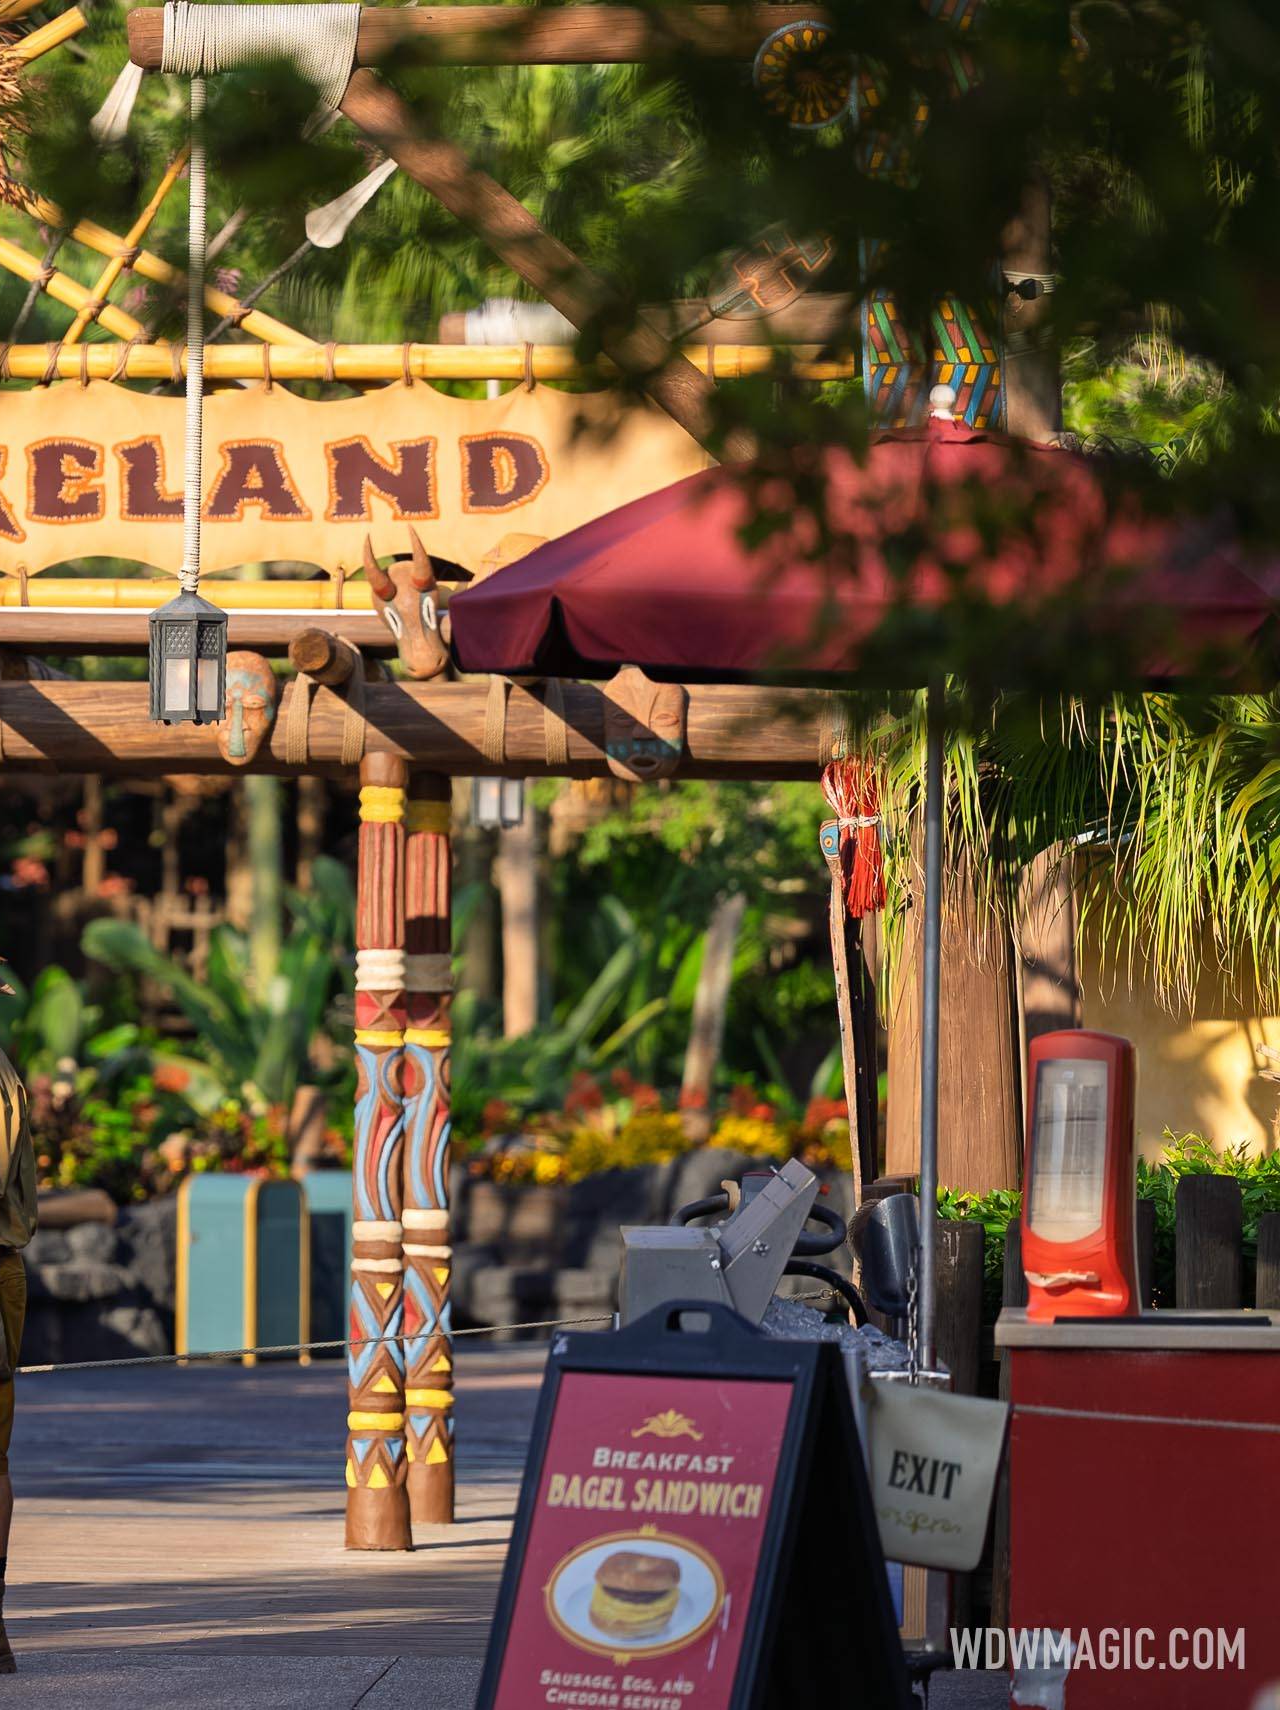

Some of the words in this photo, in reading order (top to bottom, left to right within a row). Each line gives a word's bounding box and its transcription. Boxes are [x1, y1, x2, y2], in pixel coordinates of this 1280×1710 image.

[592, 1446, 734, 1473] BREAKFAST
[887, 1449, 962, 1500] EXIT
[546, 1473, 627, 1511] BAGEL
[631, 1478, 764, 1518] SANDWICH
[539, 1669, 617, 1690] SAUSAGE,
[662, 1679, 695, 1695] AND
[545, 1688, 620, 1707] CHEDDAR
[623, 1695, 683, 1710] SERVED
